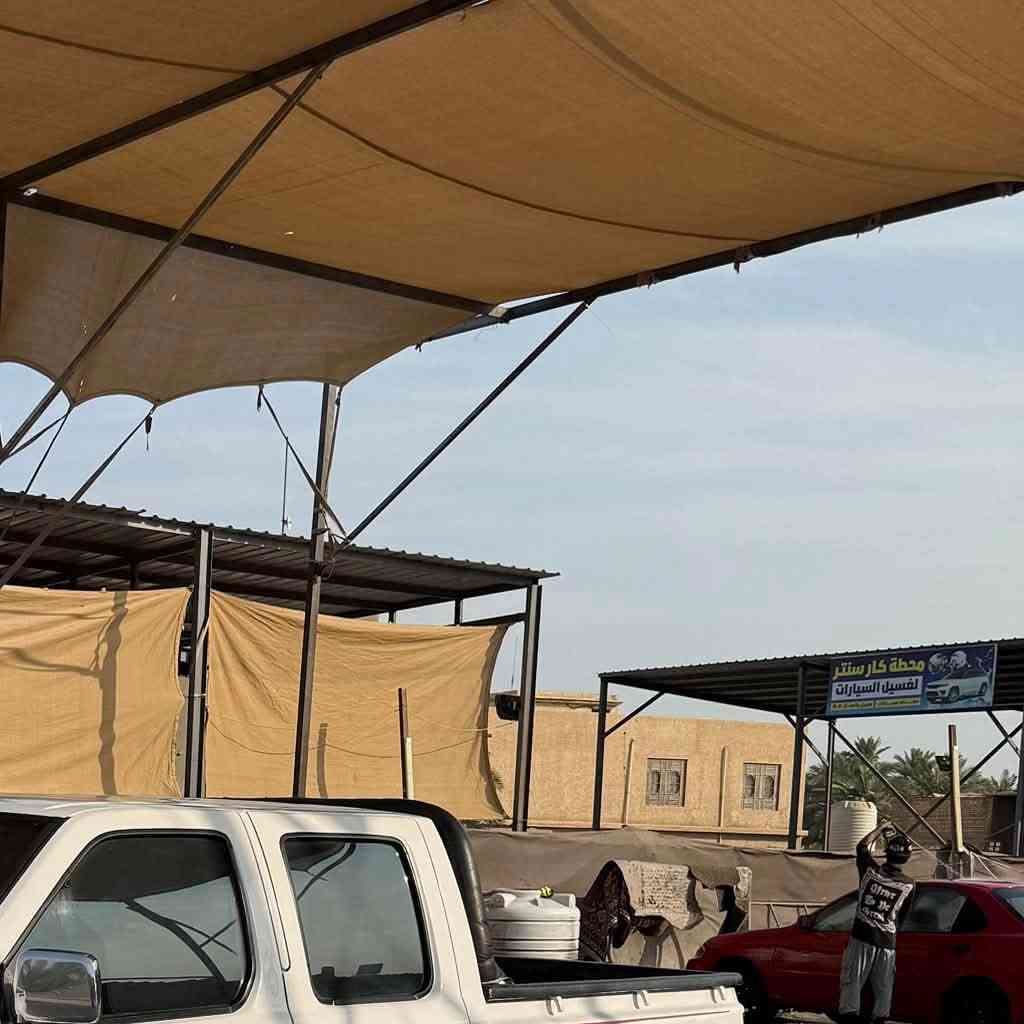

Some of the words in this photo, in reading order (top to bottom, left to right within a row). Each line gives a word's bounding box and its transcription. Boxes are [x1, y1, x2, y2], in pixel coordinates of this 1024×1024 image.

[832, 662, 865, 681] سنتر
[864, 659, 887, 678] كار
[889, 657, 926, 673] محطة
[835, 680, 880, 697] السيارات
[882, 678, 919, 695] لغسيل
